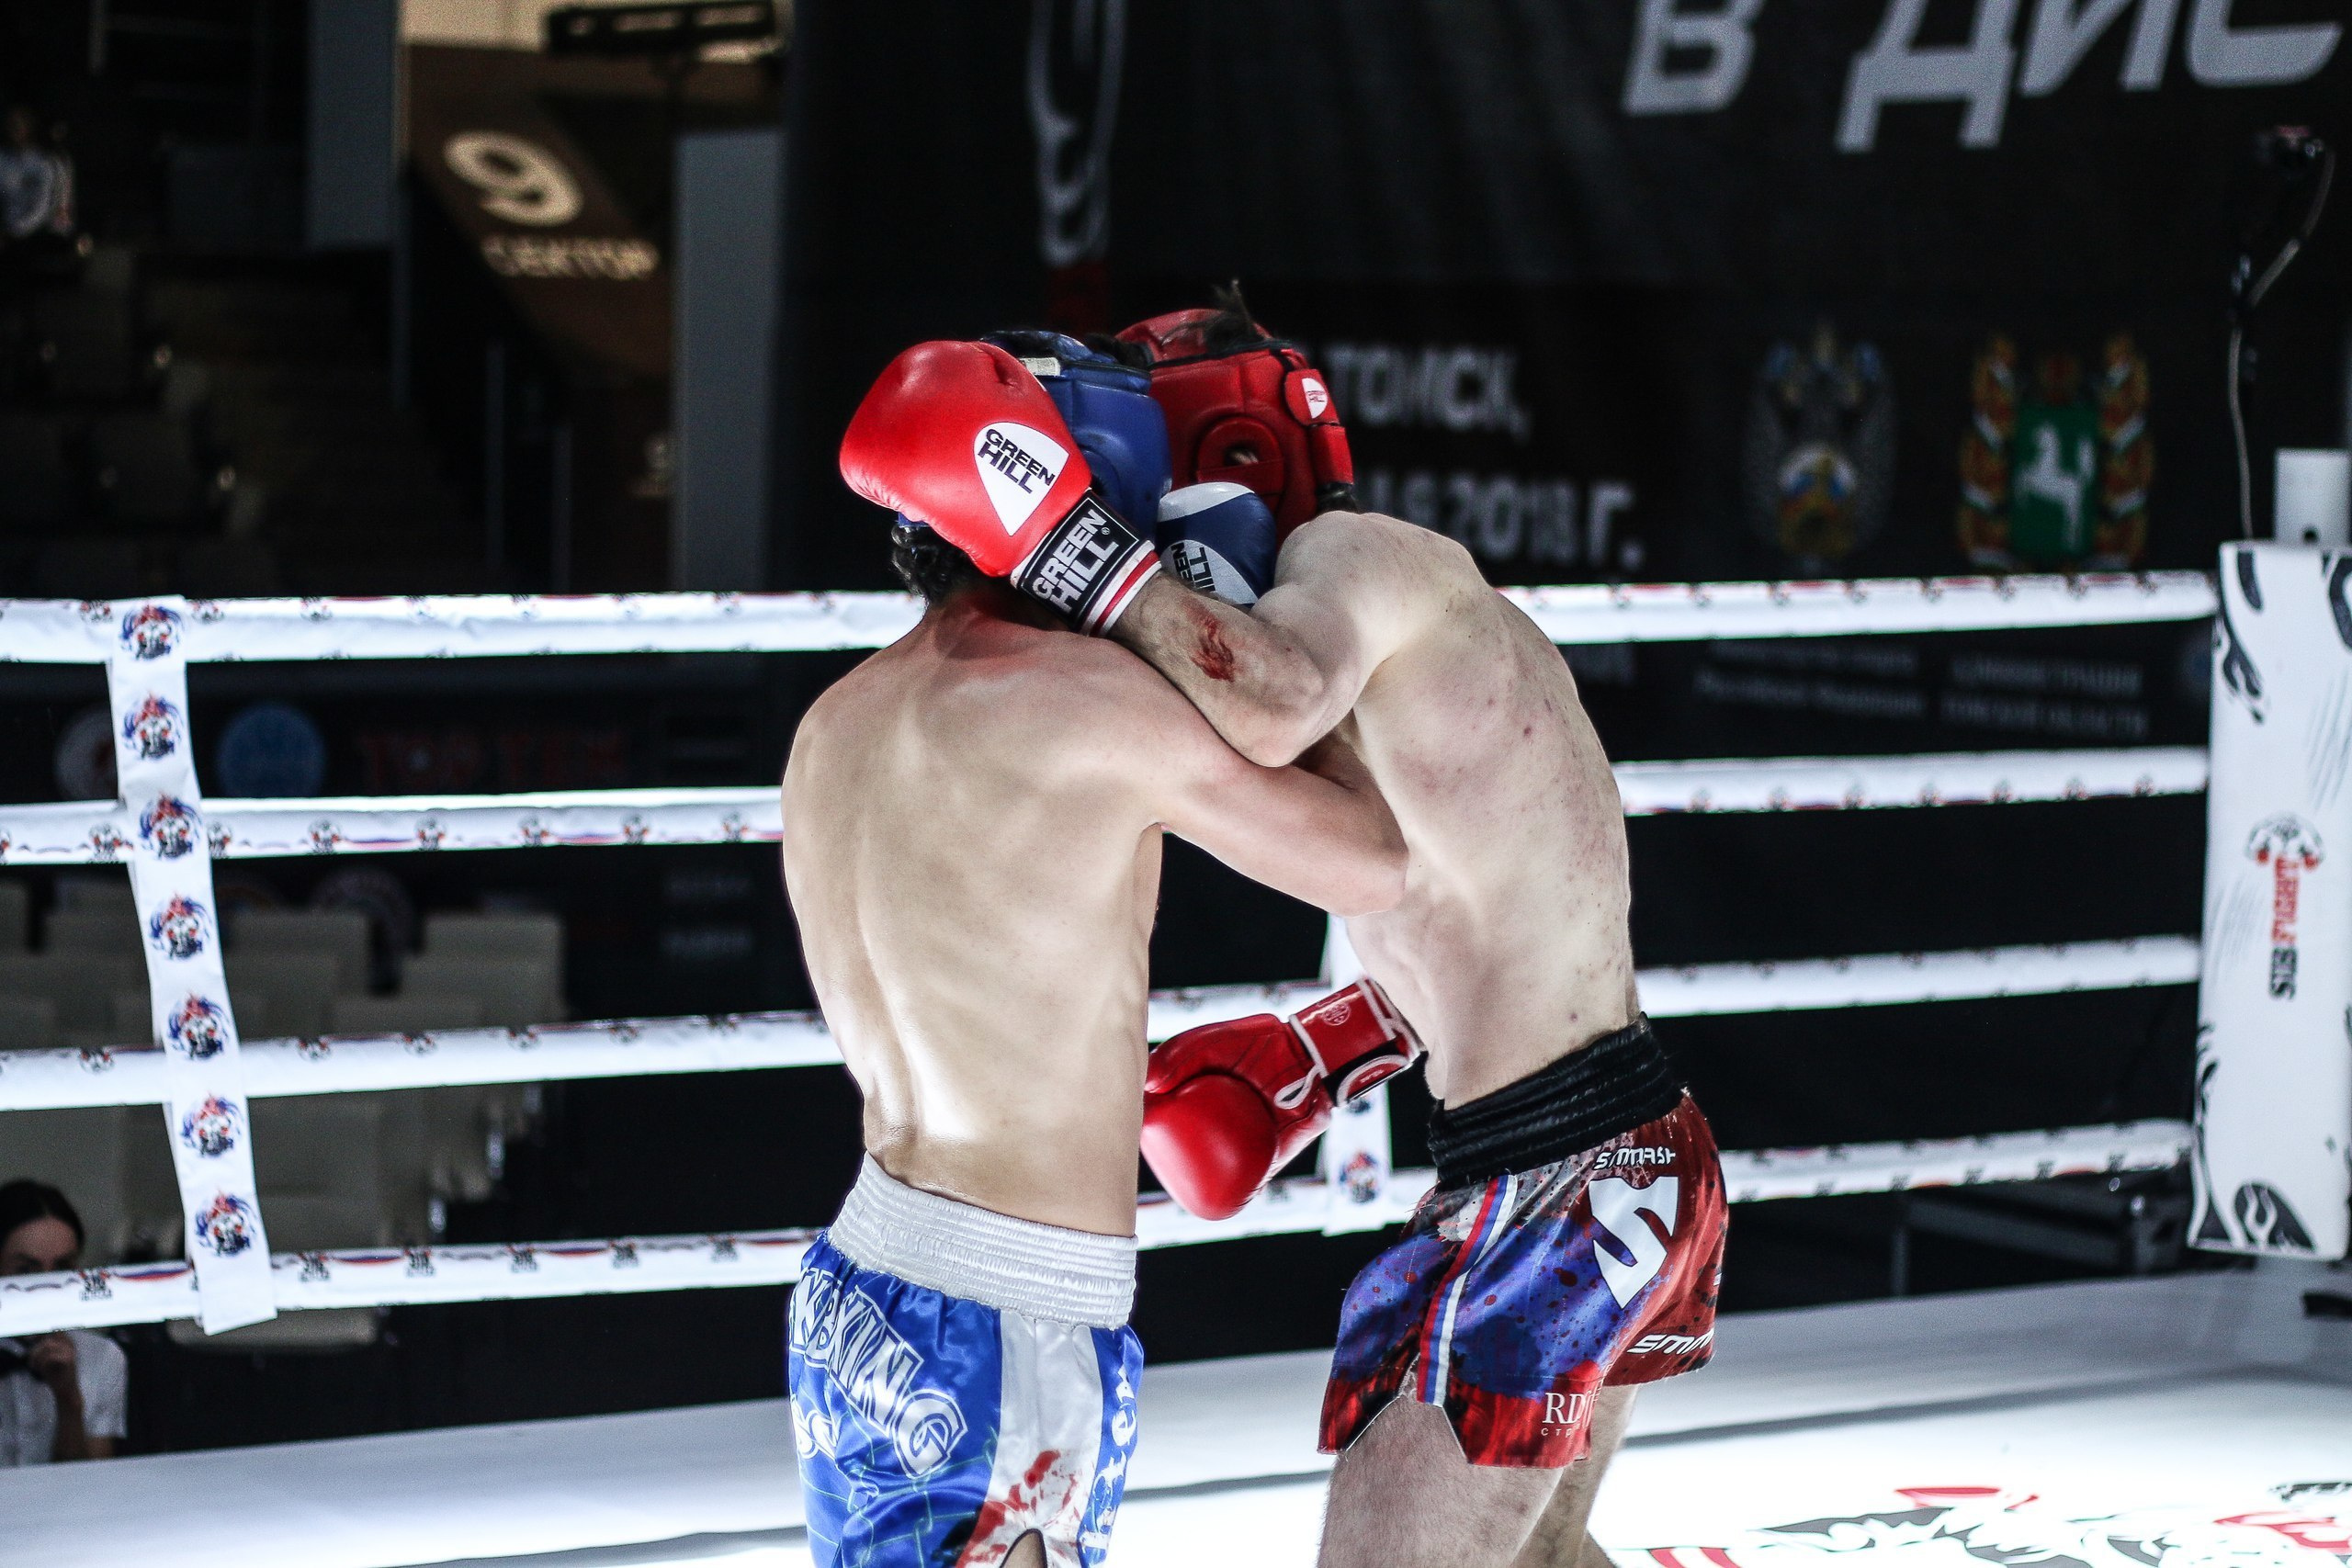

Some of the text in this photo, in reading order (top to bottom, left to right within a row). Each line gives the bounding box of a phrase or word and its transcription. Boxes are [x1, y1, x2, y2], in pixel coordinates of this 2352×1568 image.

[443, 130, 583, 229] 9
[977, 441, 1034, 494] HILL
[985, 428, 1057, 487] GREEN
[1032, 508, 1108, 601] GREEN
[1049, 539, 1120, 614] HILL
[2267, 946, 2299, 999] SIB
